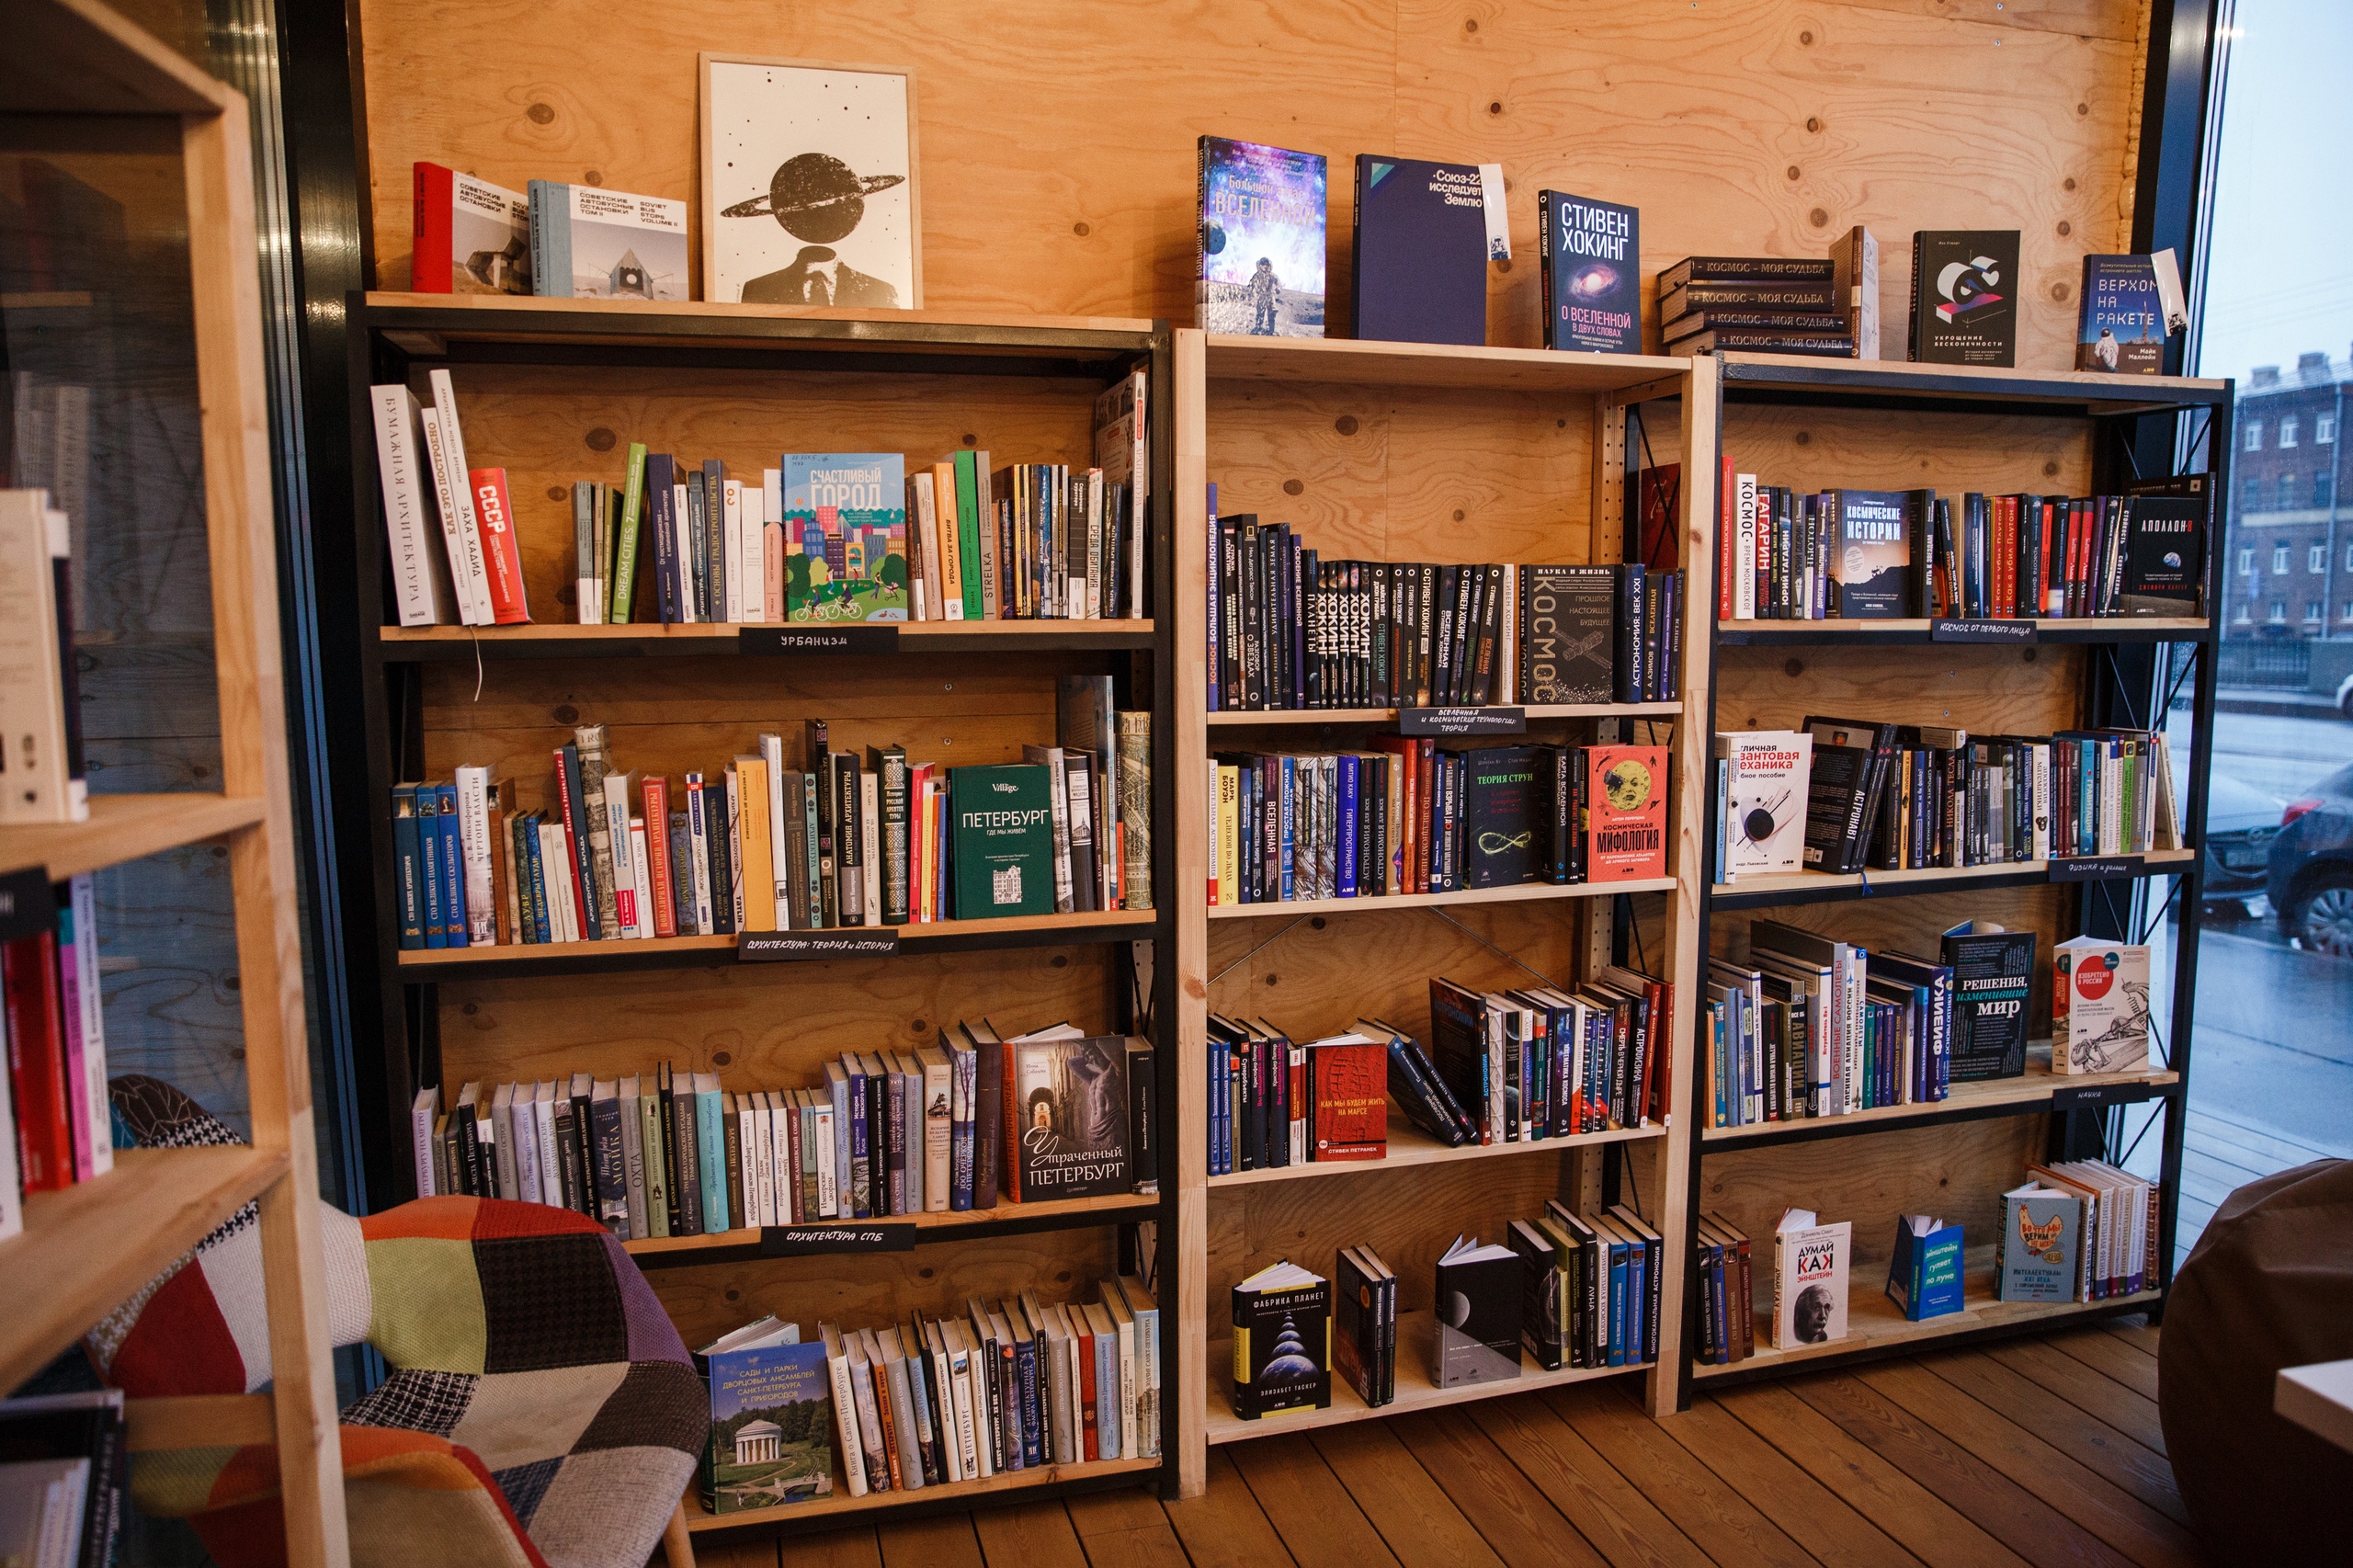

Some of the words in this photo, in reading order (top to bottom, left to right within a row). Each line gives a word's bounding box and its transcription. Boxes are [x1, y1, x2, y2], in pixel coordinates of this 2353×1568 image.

[1228, 175, 1274, 195] Большой
[1428, 183, 1482, 196] исследует
[580, 192, 628, 203] СОВЕТСКИЕ
[580, 199, 634, 210] АВТОБУСНЫЕ
[641, 201, 666, 210] SOVIET
[1445, 194, 1483, 208] Землю
[580, 204, 629, 215] ОСТАНОВКИ
[1215, 191, 1315, 229] ВСЕЛЕННОЙ
[642, 218, 672, 226] VOLUME
[1562, 202, 1629, 237] СТИВЕН
[1562, 228, 1629, 261] ХОКИНГ
[1706, 262, 1750, 274] КОСМОС
[1761, 262, 1784, 274] МОЯ
[1785, 263, 1825, 276] СУДЬБА
[2098, 279, 2158, 291] ВЕРХОМ
[1701, 292, 1747, 303] КОСМОС
[1757, 292, 1781, 303] МОЯ
[1783, 292, 1824, 305] СУДЬБА
[2097, 297, 2117, 308] НА
[1562, 306, 1569, 320] О
[1571, 306, 1631, 329] ВСЕЛЕННОЙ
[1717, 313, 1761, 325] КОСМОС
[1770, 314, 1793, 326] МОЯ
[1795, 315, 1835, 329] СУДЬБА
[2097, 313, 2154, 325] РАКЕТЕ
[1573, 323, 1577, 332] В
[1578, 324, 1596, 335] ДВУХ
[1597, 325, 1621, 337] СЛОВАХ
[1730, 335, 1772, 347] КОСМОС
[1781, 336, 1803, 348] МОЯ
[1804, 337, 1843, 350] СУДЬБА
[810, 467, 881, 483] СЧАСТЛИВЫЙ
[385, 398, 405, 484] БУМАЖНАЯ
[398, 492, 419, 602] АРХИТЕКТУРА
[811, 483, 883, 510] ГОРОД
[1741, 482, 1754, 539] КОСМОС
[1847, 506, 1901, 519] КОСМИЧЕСКИЕ
[627, 516, 634, 525] 7
[2142, 519, 2193, 533] АПОЛЛОН-8
[1090, 525, 1099, 549] СРЕДА
[1758, 494, 1769, 570] ГАГАРИН
[1847, 521, 1901, 540] ИСТОРИИ
[460, 506, 472, 534] ЗАХА
[467, 540, 481, 577] ХАДИД
[621, 526, 634, 560] CITIES:
[1208, 514, 1217, 593] ЭНЦИКЛОПЕДИЯ
[984, 551, 993, 598] STRELKA
[1088, 551, 1098, 588] ОБИТАНИЯ
[618, 560, 631, 599] DREAM
[1574, 595, 1610, 603] ПРОШЛОЕ
[1210, 594, 1218, 642] БОЛЬШАЯ
[1569, 607, 1610, 615] НАСТОЯЩЕЕ
[1307, 594, 1315, 653] ПЛАНЕТЫ
[1317, 593, 1328, 660] ХОКИНГ
[1338, 593, 1349, 656] ХОКИНГ
[1360, 592, 1370, 664] ХОКИНГ
[1580, 619, 1610, 628] БУДУЩЕЕ
[1940, 623, 1969, 632] КОСМОС
[1970, 624, 1980, 632] ОТ
[1980, 624, 2008, 633] ПЕРВОГО
[2008, 627, 2030, 636] ЛИЦА
[781, 636, 847, 646] УРБАНИЗМ
[1532, 576, 1556, 703] КОСМОС
[1210, 644, 1218, 685] КОСМОС
[1441, 723, 1468, 732] ТЕОРИЯ
[1740, 744, 1777, 753] тличная
[1740, 751, 1800, 761] вантовая
[1740, 760, 1793, 769] еханика
[1477, 775, 1507, 785] ТЕОРИЯ
[1509, 773, 1533, 782] СТРУН
[472, 777, 482, 816] ВЛАСТИ
[844, 770, 852, 824] АРХИТЕКТУРЫ
[962, 810, 1049, 828] ПЕТЕРБУРГ
[1847, 790, 1866, 842] АСТРОНАВТ
[1267, 801, 1277, 853] ВСЕЛЕННАЯ
[1603, 822, 1654, 831] КОСМИЧЕСКАЯ
[475, 820, 483, 862] ЧЕРТОГИ
[846, 825, 854, 865] АНАТОМИЯ
[1345, 807, 1354, 880] ГИПЕРПРОСТРАНСТВО
[1597, 828, 1659, 854] МИФОЛОГИЯ
[2068, 863, 2097, 872] ФИЗИКА
[2105, 864, 2127, 874] дальше
[813, 940, 847, 949] ТЕОРИЯ
[855, 939, 894, 952] ИСТОРИЯ
[1962, 976, 2028, 991] РЕШЕНИЯ,
[2077, 971, 2109, 980] ИЗОБРЕТЕНО
[1834, 960, 1842, 1024] САМОЛЕТЫ
[1956, 988, 2028, 1002] изменившие
[1933, 975, 1945, 1056] ФИЗИКА
[1977, 999, 2020, 1018] мир
[1633, 1028, 1645, 1082] АСТРОФИЗИКА
[1792, 1022, 1804, 1089] АВИАЦИИ
[1832, 1026, 1840, 1080] ВОЕННЫЕ
[1367, 1097, 1385, 1106] ЖИТЬ
[1347, 1107, 1368, 1115] МАРСЕ
[1023, 1126, 1123, 1167] Утраченный
[631, 1153, 642, 1187] ОХТА
[1029, 1163, 1124, 1187] ПЕТЕРБУРГ
[787, 1231, 856, 1241] АРХИТЕКТУРА
[860, 1233, 883, 1242] СПБ
[1798, 1241, 1835, 1258] ДУМАЙ
[1925, 1244, 1959, 1258] эйнштейн
[1929, 1258, 1951, 1272] гуляет
[1797, 1271, 1833, 1283] ЭЙНШТЕЙН
[1936, 1272, 1955, 1284] луне
[1253, 1299, 1290, 1309] ФАБРИКА
[1294, 1291, 1324, 1302] ПЛАНЕТ
[739, 1369, 761, 1377] САДЫ
[774, 1364, 798, 1373] ПАРКИ
[722, 1378, 767, 1390] ДВОРЦОВЫХ
[770, 1369, 815, 1381] АНСАМБЛЕЙ
[737, 1381, 801, 1396] САНКТ-ПЕТЕРБУРГА
[750, 1391, 799, 1403] ПРИГОРОДОВ
[1260, 1386, 1291, 1396] ЭЛИЗАБЕТ
[1294, 1382, 1317, 1392] ТАСКЕР
[836, 1366, 853, 1442] Санкт-Петербурге
[850, 1450, 858, 1477] Книга
